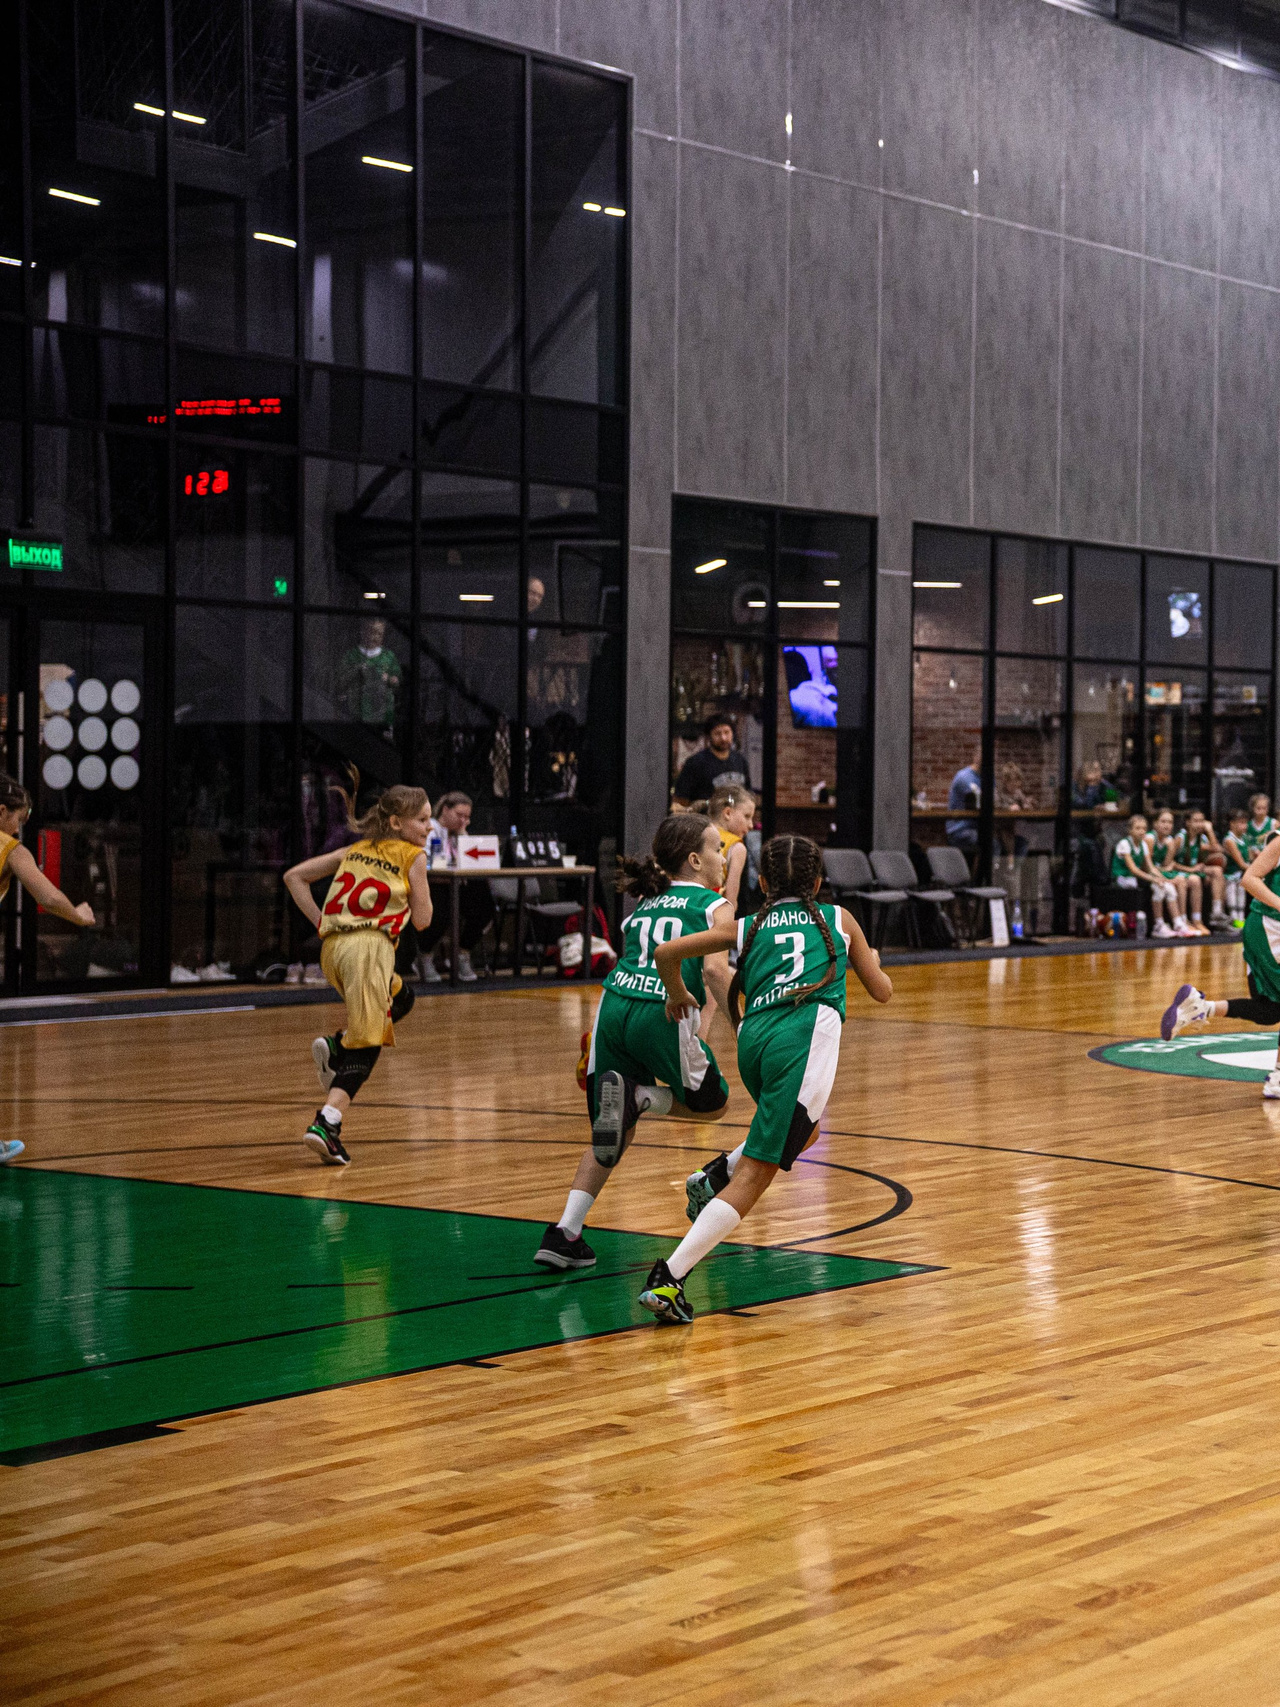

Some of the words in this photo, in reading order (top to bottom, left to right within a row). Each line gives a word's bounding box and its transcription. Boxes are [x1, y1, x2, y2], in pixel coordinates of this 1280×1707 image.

[12, 545, 62, 569] ВЫХОД
[324, 871, 391, 918] 20
[753, 909, 826, 931] ИВАНО
[774, 931, 805, 985] 3
[611, 971, 668, 1001] ЛИПЕЦ
[752, 982, 812, 1009] ЛИПЕ
